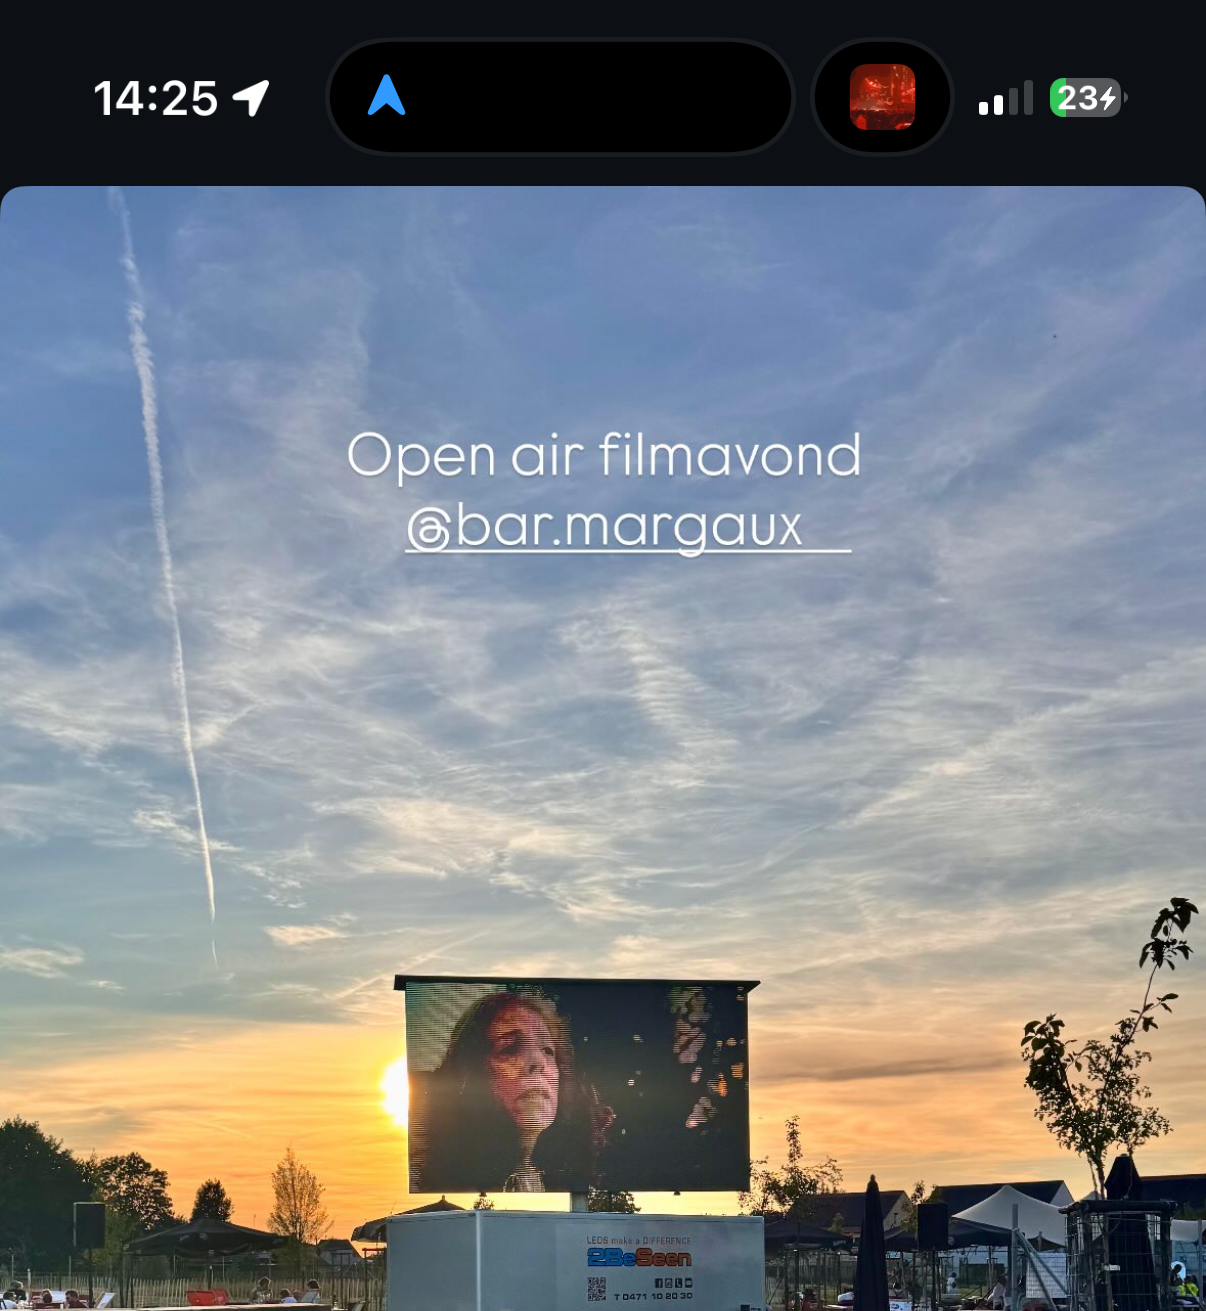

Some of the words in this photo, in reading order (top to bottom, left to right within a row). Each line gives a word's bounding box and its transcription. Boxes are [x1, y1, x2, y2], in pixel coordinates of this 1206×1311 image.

[587, 1235, 609, 1245] LEDS
[611, 1236, 633, 1245] make
[642, 1236, 692, 1246] DIFFERENCE
[587, 1247, 692, 1267] 2BeSeen
[614, 1293, 621, 1301] T
[622, 1293, 648, 1301] 0471
[665, 1292, 678, 1300] 20
[680, 1292, 693, 1300] 30
